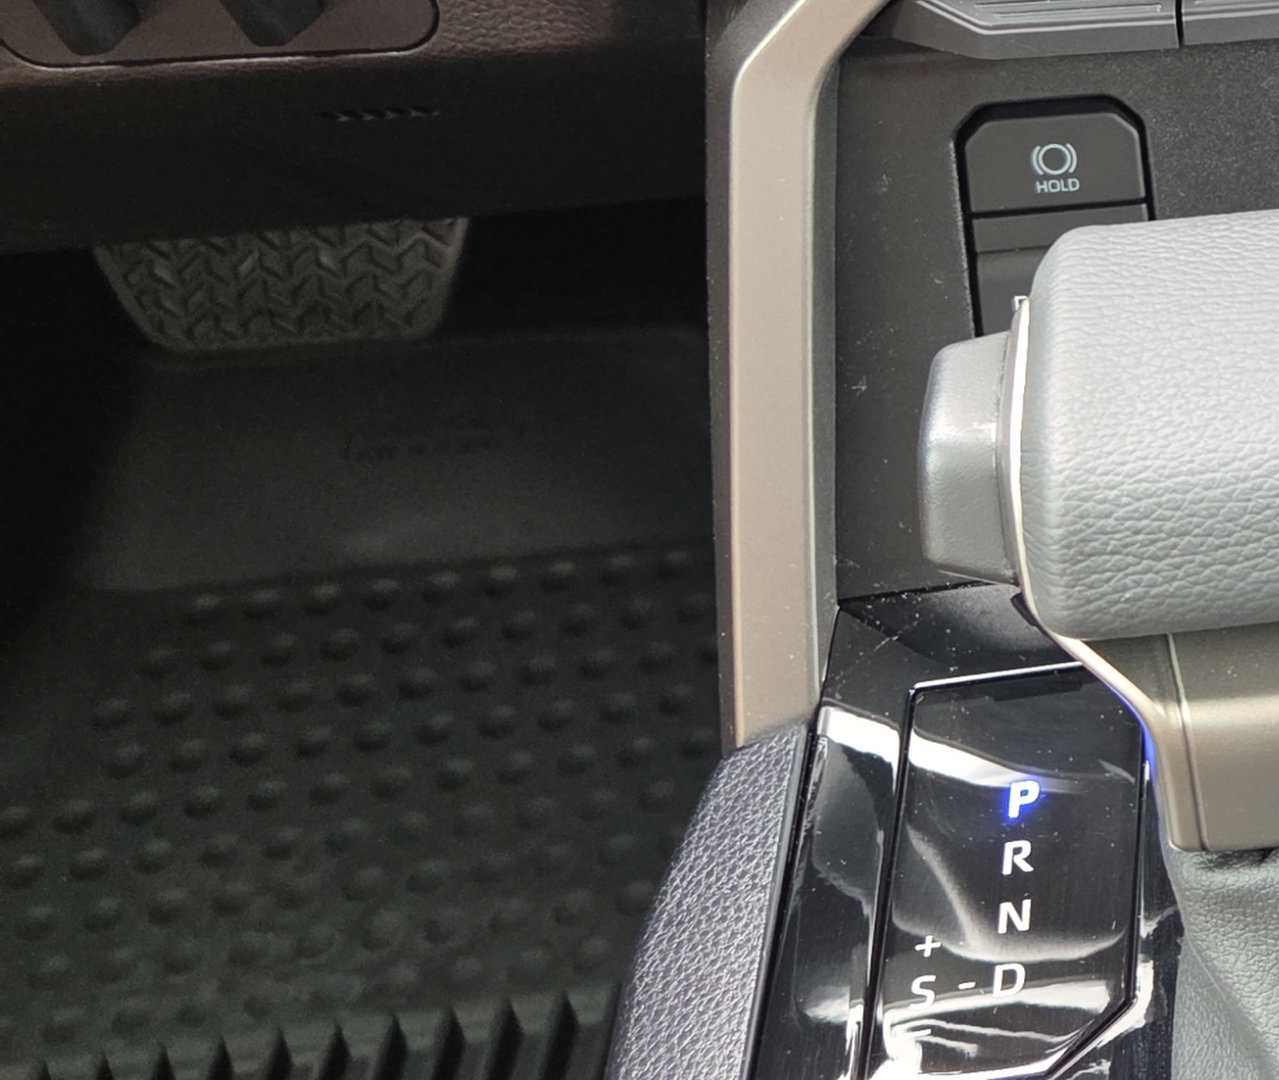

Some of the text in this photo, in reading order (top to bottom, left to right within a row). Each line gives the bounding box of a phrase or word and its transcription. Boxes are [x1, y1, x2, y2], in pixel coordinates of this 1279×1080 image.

[1035, 177, 1081, 194] HOLD
[1008, 779, 1041, 819] P
[1002, 838, 1035, 876] R
[998, 898, 1033, 935] N
[908, 974, 937, 1011] S
[993, 962, 1027, 998] D
